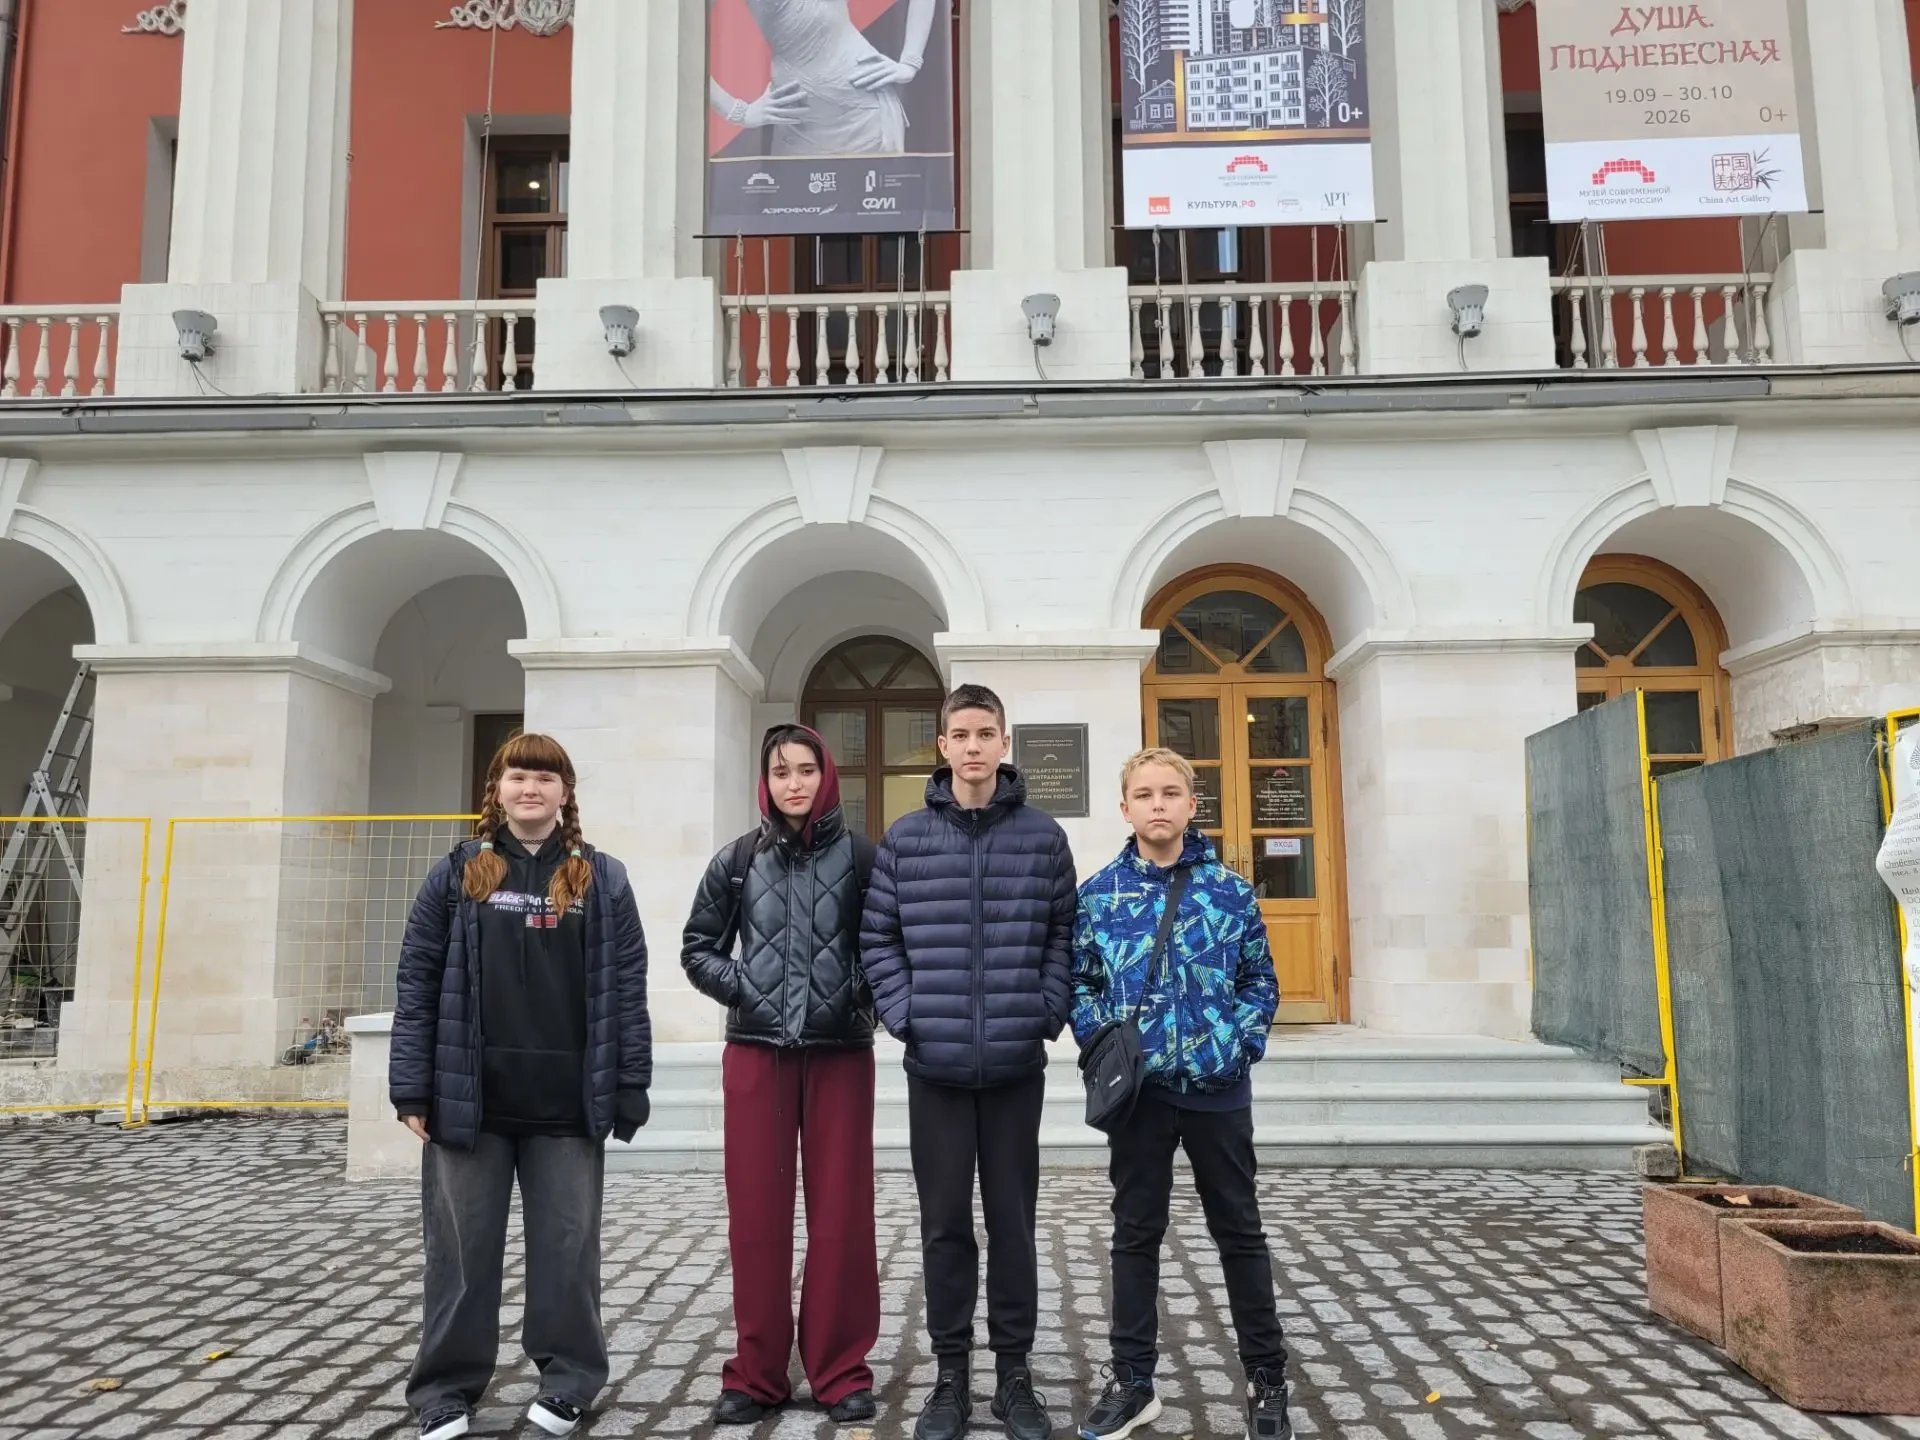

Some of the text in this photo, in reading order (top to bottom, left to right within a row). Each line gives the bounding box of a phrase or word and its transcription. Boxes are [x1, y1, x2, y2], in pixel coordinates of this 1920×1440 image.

[1610, 4, 1714, 36] ДУША.
[1604, 88, 1656, 104] 19.09
[1679, 85, 1732, 101] 30.10
[1338, 102, 1363, 123] 0+
[1644, 109, 1691, 125] 2026
[1759, 106, 1788, 123] 0+
[1579, 186, 1671, 197] МУЗЕЙ СОВРЕМЕННОЙ
[1699, 193, 1771, 205] China Art Gallery
[1187, 200, 1256, 209] КУЛЬТУРА.РФ
[1588, 196, 1663, 206] ИСТОРИИ РОССИИ
